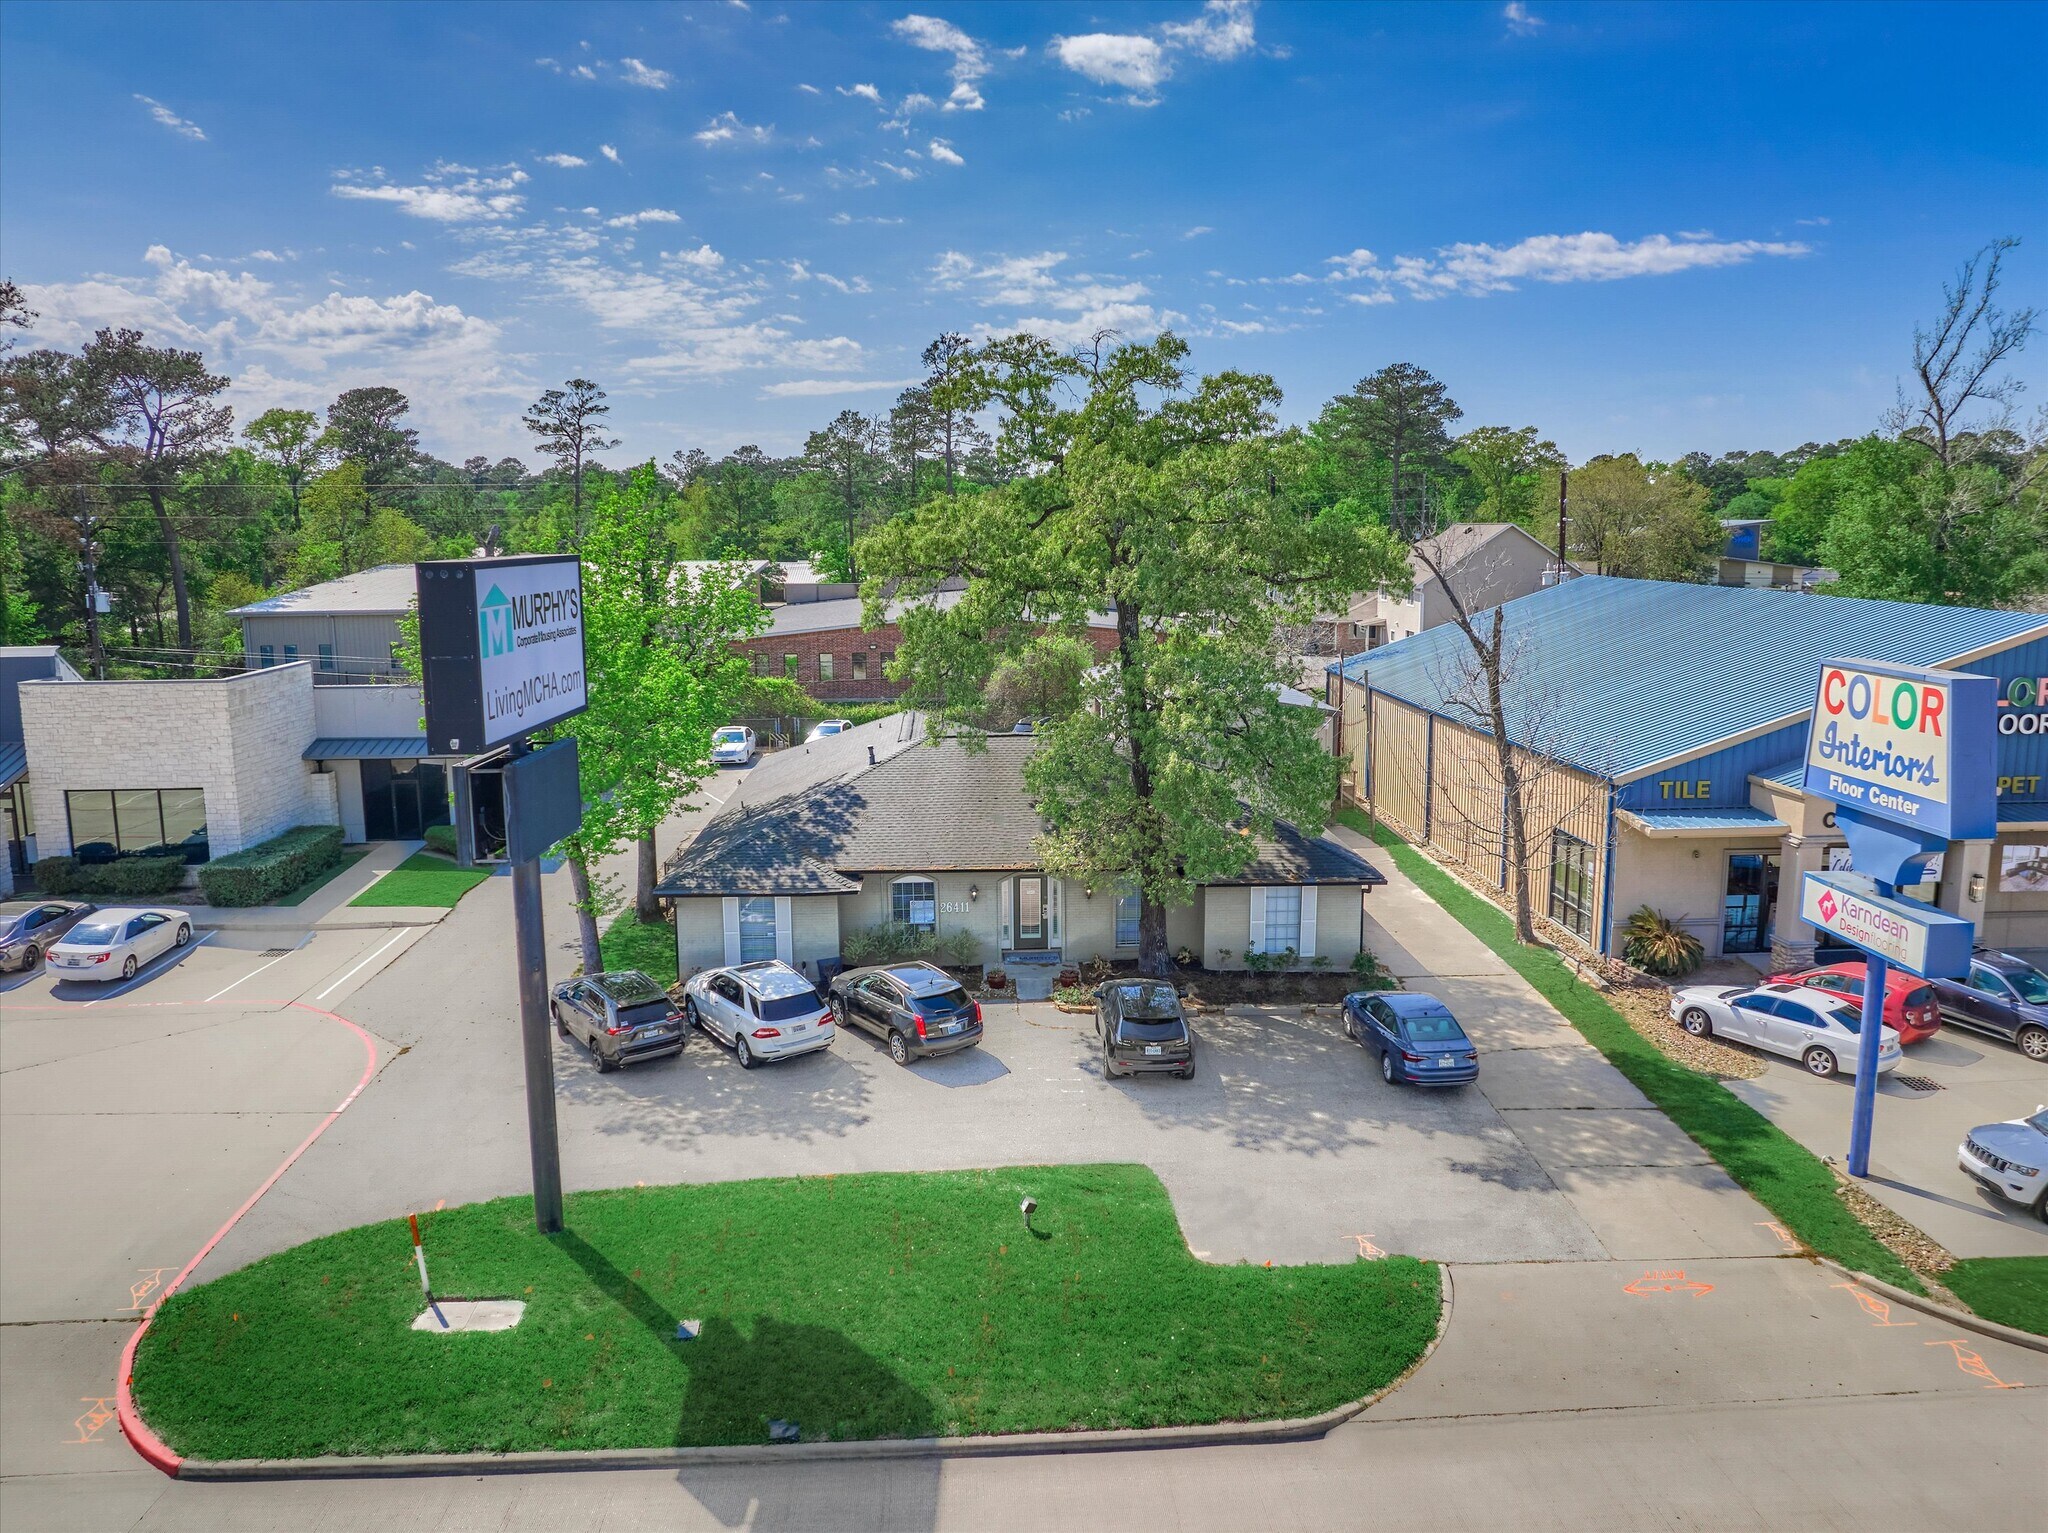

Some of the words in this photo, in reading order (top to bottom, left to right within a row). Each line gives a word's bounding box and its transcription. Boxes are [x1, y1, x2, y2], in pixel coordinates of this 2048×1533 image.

[512, 588, 578, 630] MURPHY'S
[486, 670, 581, 720] LivingMCHA.com
[1824, 670, 1944, 737] COLOR
[1819, 721, 1939, 786] Interiors
[1659, 781, 1711, 799] TILE
[1829, 774, 1865, 800] Floor
[1868, 787, 1920, 816] Center
[940, 902, 970, 913] 26411
[1840, 894, 1909, 942] Karndean
